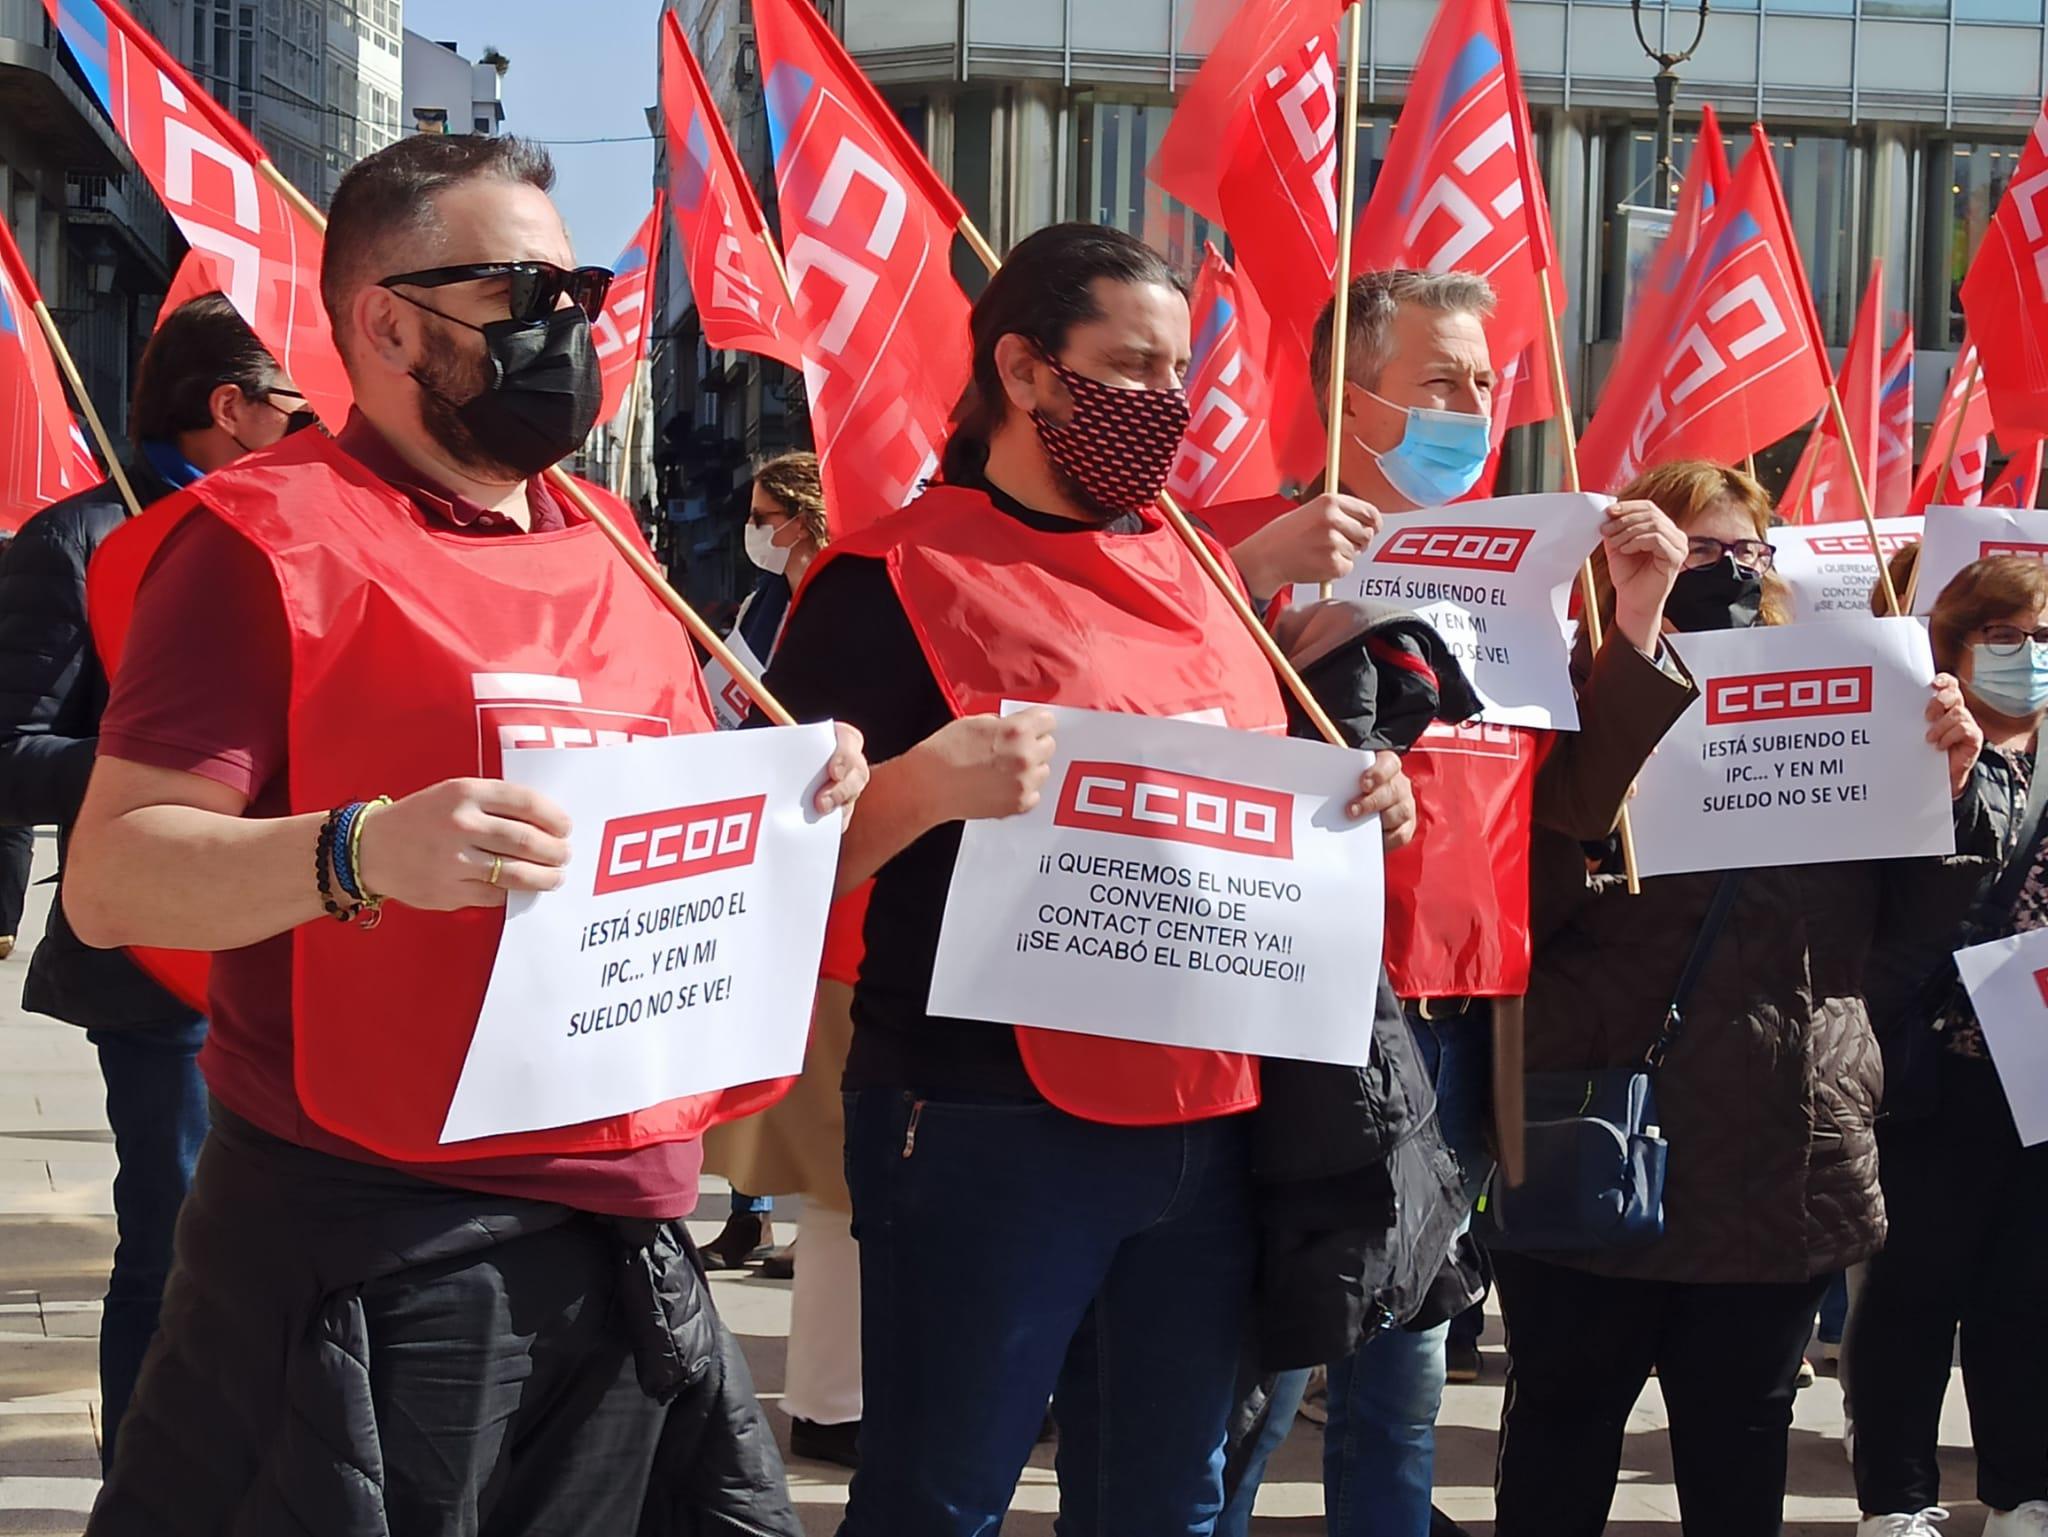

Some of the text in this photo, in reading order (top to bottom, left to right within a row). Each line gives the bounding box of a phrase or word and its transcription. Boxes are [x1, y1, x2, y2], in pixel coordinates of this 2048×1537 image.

[1389, 533, 1520, 561] CCOO
[1359, 575, 1508, 606] ¡ESTÁ SUBIENDO EL
[1428, 611, 1487, 634] Y EN MI
[1467, 643, 1484, 661] SE
[1485, 645, 1510, 665] VE!
[1717, 677, 1860, 714] CCOO
[1702, 729, 1870, 760] ¡ESTÁ SUBIENDO EL
[1726, 759, 1844, 783] IPC... Y EN MI
[1074, 776, 1277, 844] CCOO
[1702, 784, 1868, 812] SUELDO NO SE VE!
[608, 813, 753, 877] CCOO
[1058, 853, 1191, 887] QUEREMOS
[1198, 872, 1222, 893] EL
[1227, 876, 1302, 902] NUEVO
[1090, 884, 1246, 921] CONVENIO DE
[580, 891, 746, 952] ¡ESTÁ SUBIENDO EL
[1039, 904, 1293, 957] CONTACT CENTER YA!!
[601, 939, 717, 988] IPC... Y EN MI
[1016, 930, 1306, 983] ¡¡SE ACABÓ EL BLOQUEO!!
[566, 975, 732, 1038] SUELDO NO SE VE!
